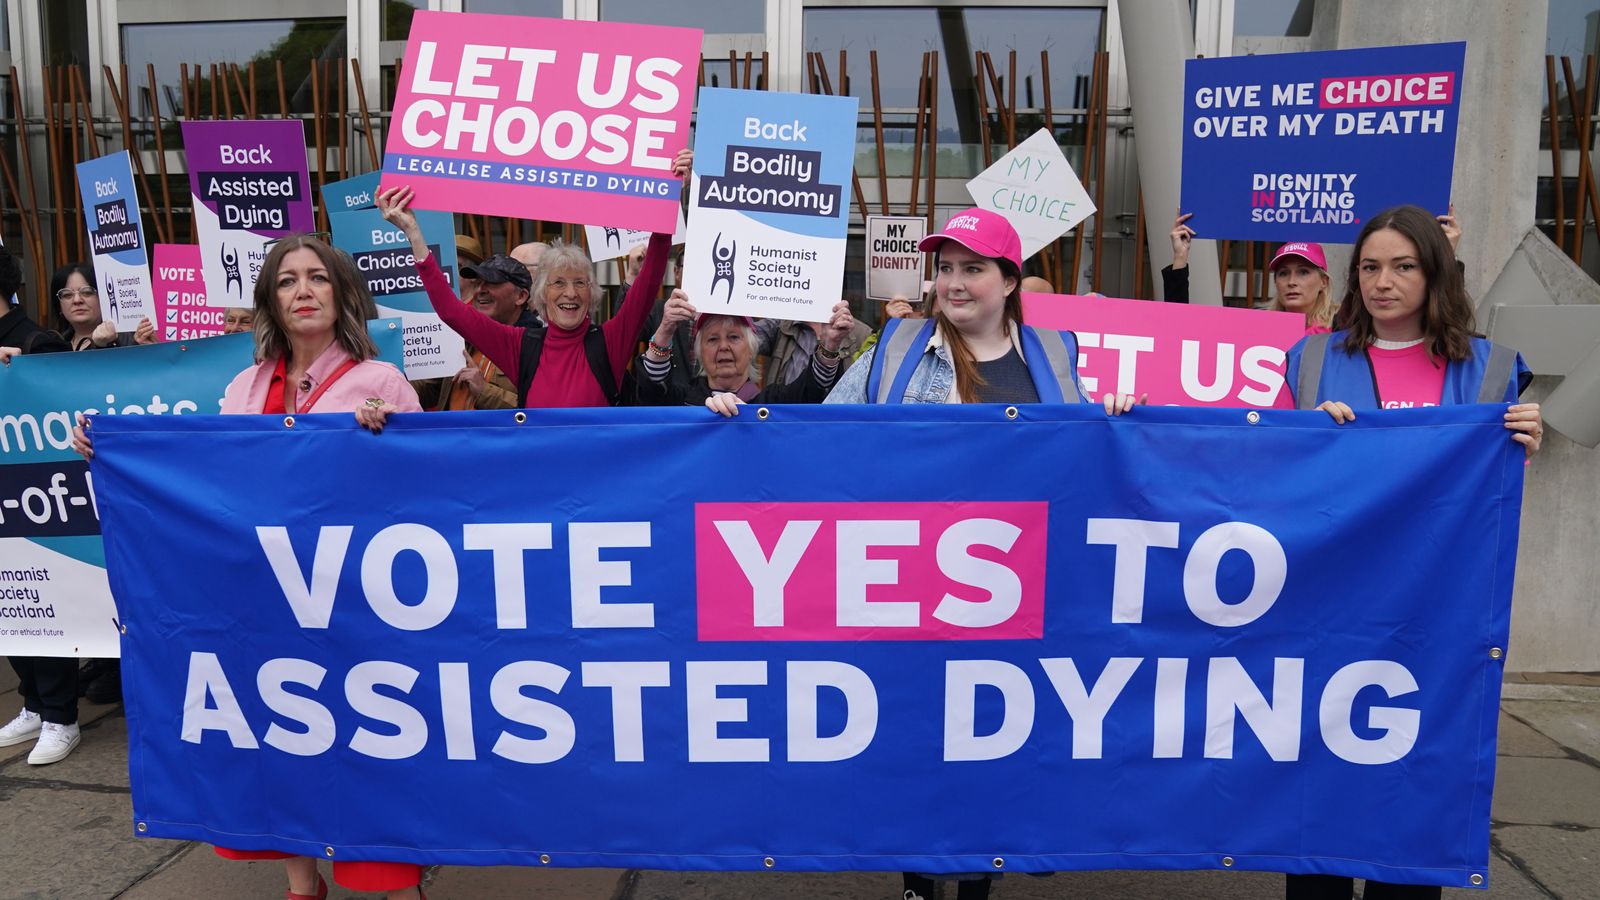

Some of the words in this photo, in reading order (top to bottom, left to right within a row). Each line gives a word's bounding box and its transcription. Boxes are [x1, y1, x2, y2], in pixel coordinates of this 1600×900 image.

[411, 41, 557, 103] LET
[576, 52, 683, 114] US
[1195, 84, 1261, 109] GIVE
[1271, 82, 1315, 106] ME
[1325, 76, 1449, 105] CHOICE
[744, 117, 807, 142] Back
[1193, 115, 1268, 138] OVER
[1278, 113, 1325, 136] MY
[1335, 109, 1445, 135] DEATH
[401, 98, 677, 171] CHOOSE
[220, 143, 272, 164] Back
[397, 157, 491, 178] LEGALISE
[500, 167, 598, 189] ASSISTED
[607, 177, 670, 196] DYING
[733, 151, 812, 183] Bodily
[1007, 156, 1050, 182] MY
[95, 177, 118, 198] Back
[208, 176, 294, 196] Assisted
[1252, 173, 1357, 191] DIGNITY
[345, 191, 371, 207] Back
[704, 180, 834, 216] Autonomy
[992, 188, 1076, 222] CHOICE
[1252, 191, 1275, 208] IN
[1279, 191, 1355, 209] DYING
[97, 204, 126, 225] Bodily
[224, 204, 283, 229] Dying
[1251, 208, 1360, 224] SCOTLAND.
[95, 230, 139, 249] Autonomy
[371, 229, 409, 245] Bac
[887, 224, 907, 238] MY
[750, 245, 817, 261] Humanist
[874, 239, 919, 254] CHOICE,
[357, 252, 415, 271] Choice
[749, 259, 801, 277] Society
[872, 256, 919, 270] DIGNITY
[117, 276, 140, 286] Humanist
[159, 267, 195, 281] VOTE
[747, 274, 811, 290] Scotland
[119, 289, 137, 298] Society
[793, 297, 813, 305] future
[120, 299, 142, 309] Scotland
[403, 345, 441, 357] otland
[1180, 339, 1288, 407] US
[0, 567, 50, 581] manist
[255, 521, 655, 631] VOTE
[713, 518, 1023, 629] YES
[1087, 517, 1288, 628] TO
[0, 628, 8, 636] or
[20, 628, 42, 636] ethical
[43, 628, 64, 637] future
[180, 651, 880, 765] ASSISTED
[943, 656, 1421, 765] DYING
